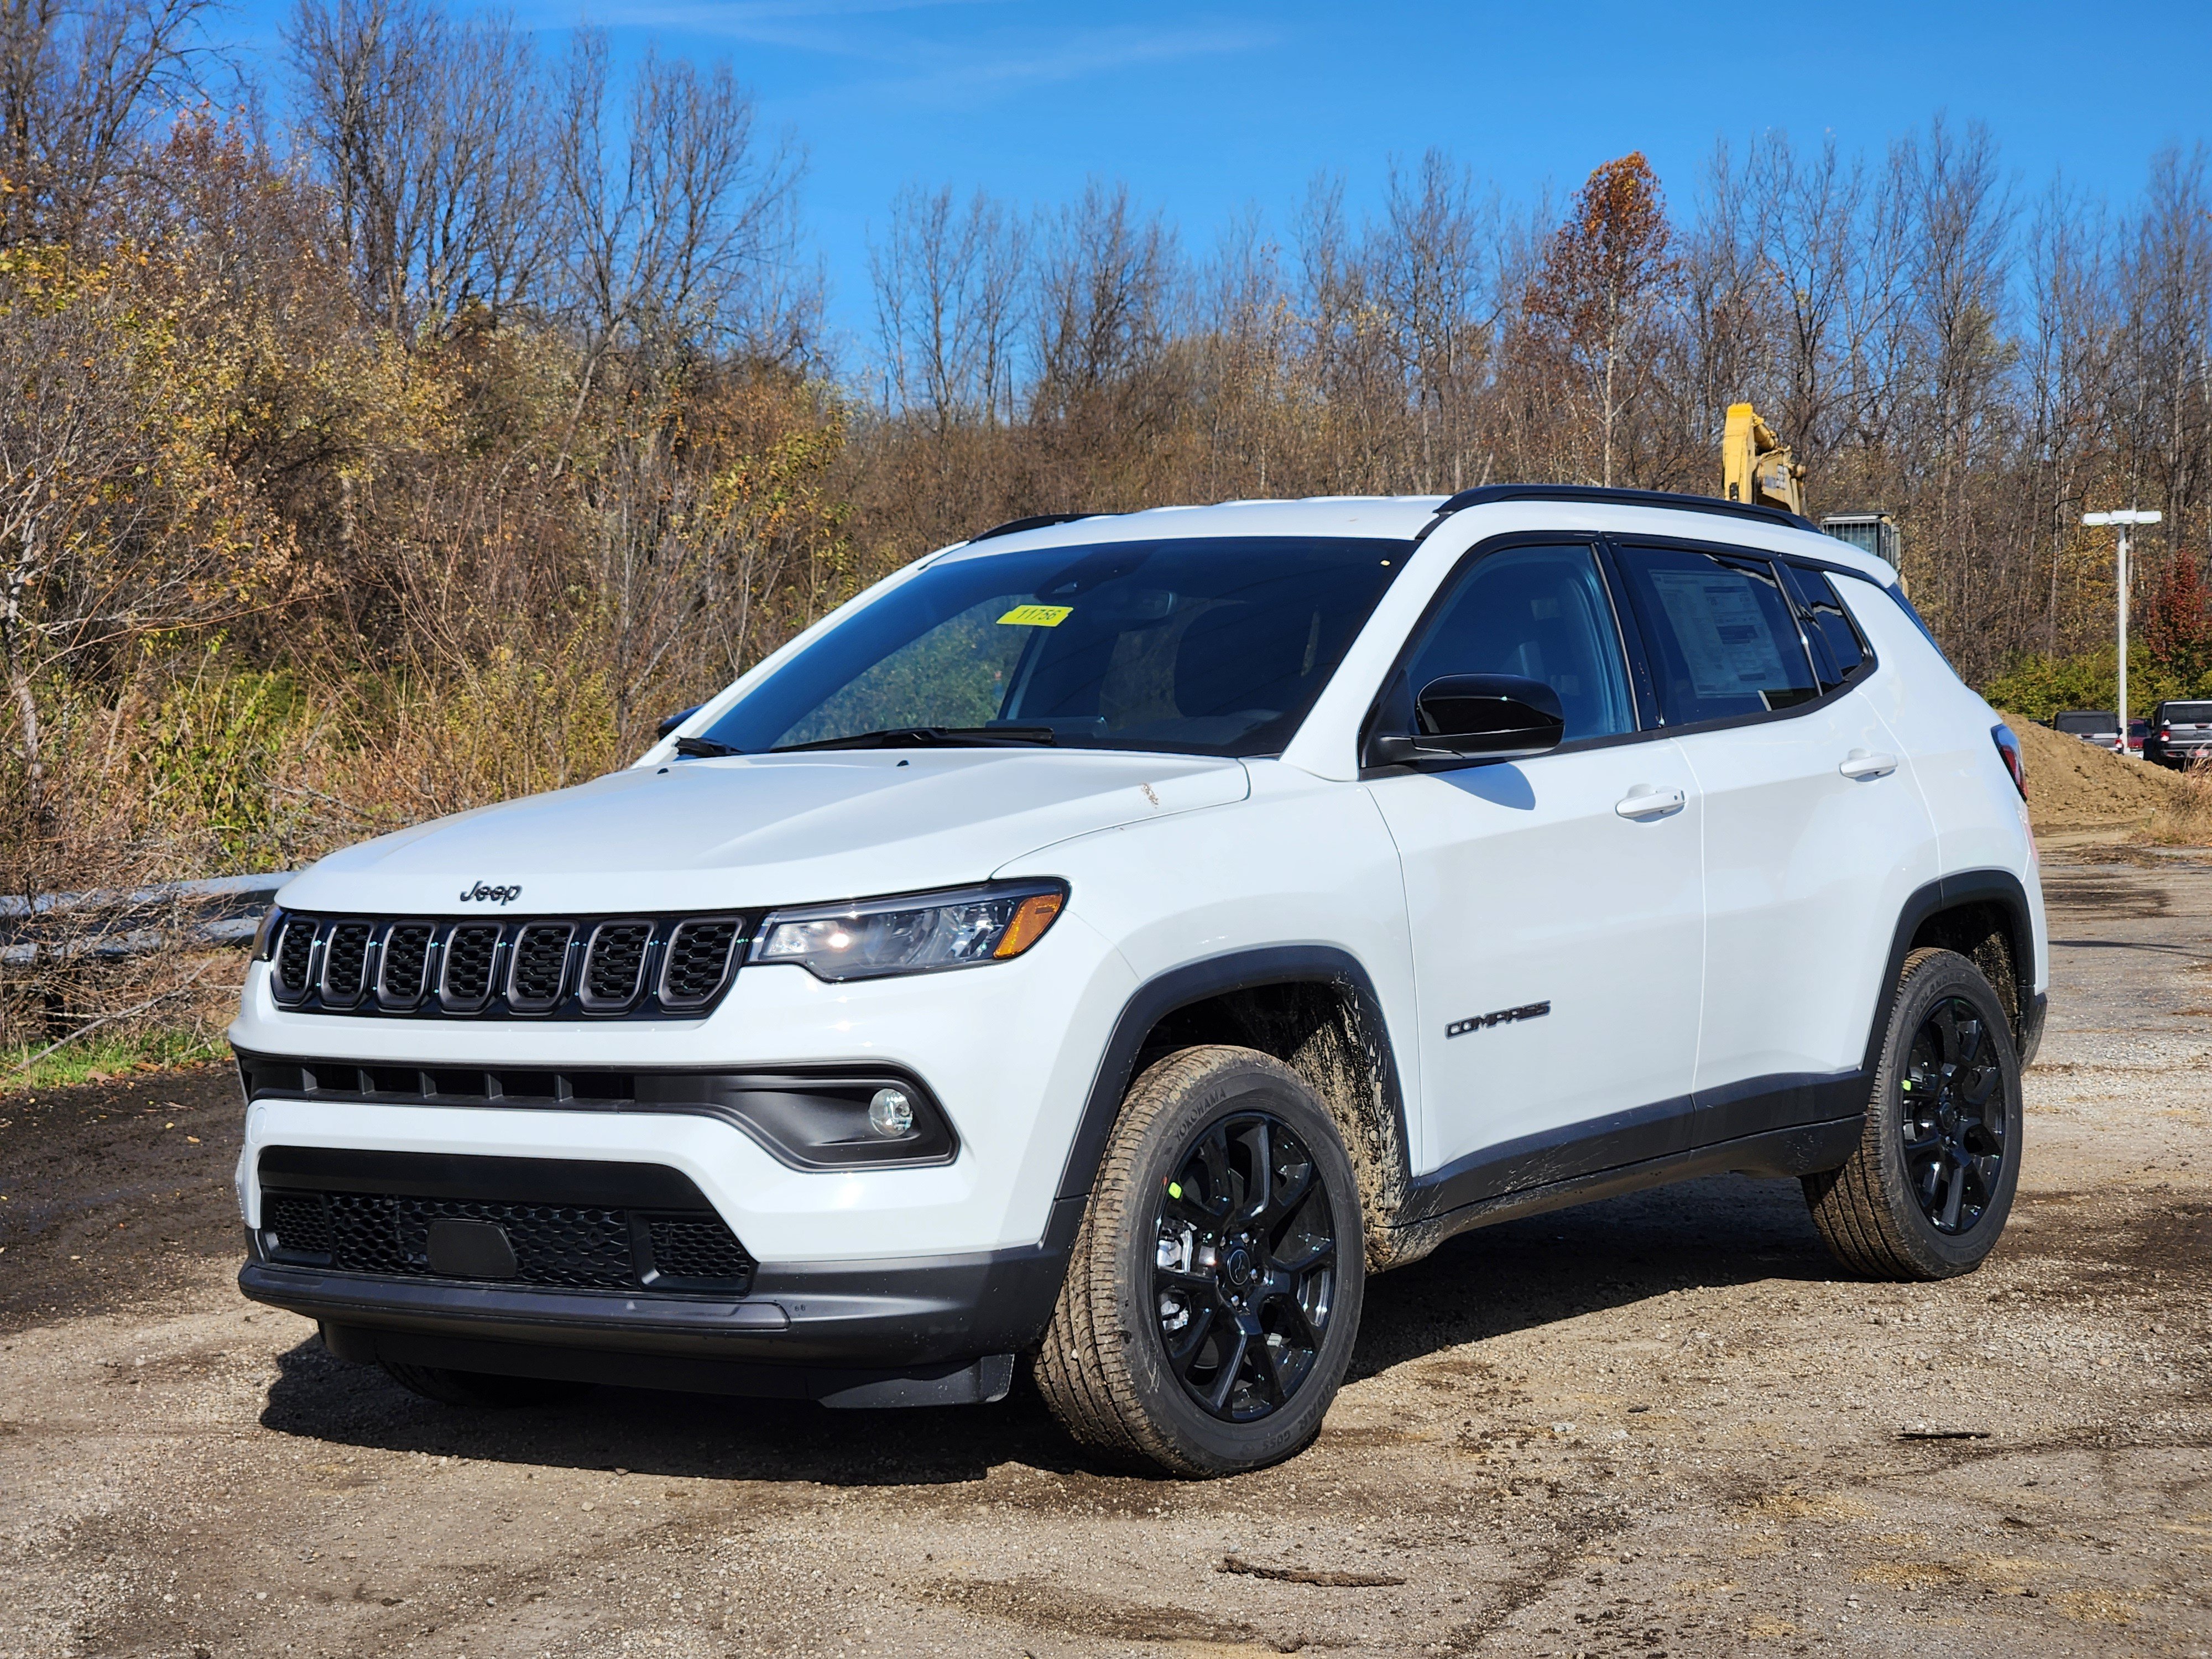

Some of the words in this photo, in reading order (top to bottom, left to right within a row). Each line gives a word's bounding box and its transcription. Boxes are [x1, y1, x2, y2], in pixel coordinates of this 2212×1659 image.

[1016, 608, 1062, 620] 11756
[460, 880, 523, 906] Jeep
[1444, 1000, 1551, 1040] COMPASS
[1176, 1085, 1227, 1141] YOKOHAMA
